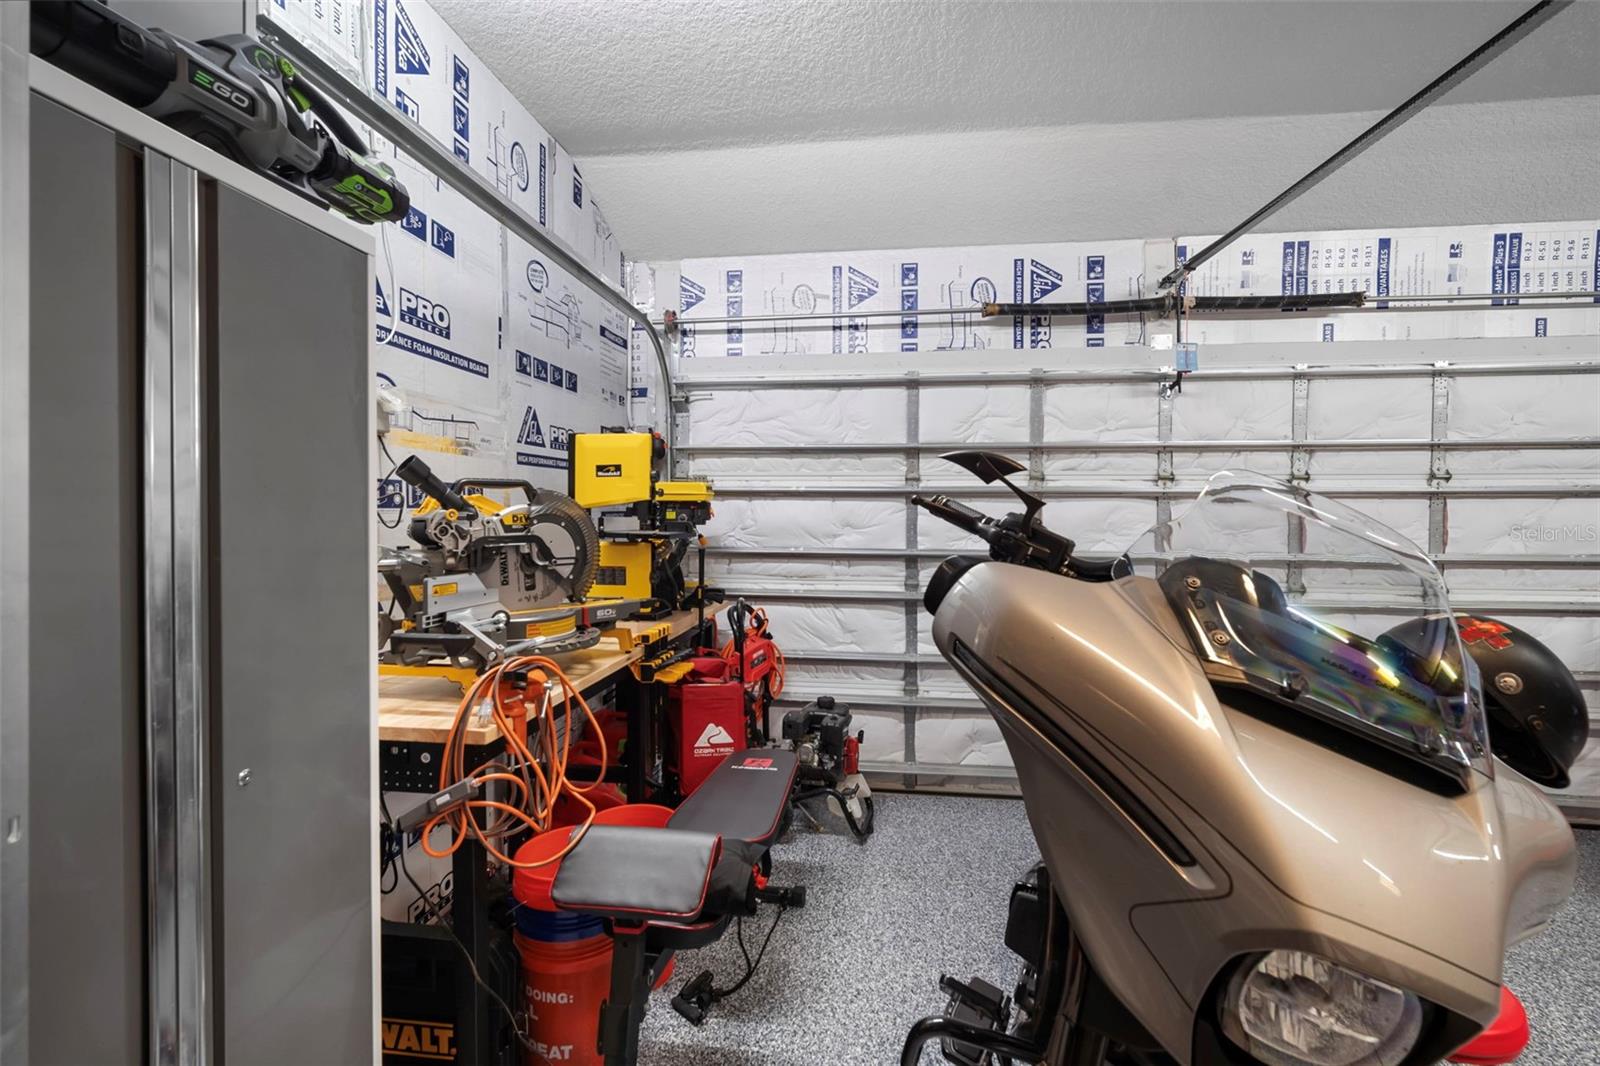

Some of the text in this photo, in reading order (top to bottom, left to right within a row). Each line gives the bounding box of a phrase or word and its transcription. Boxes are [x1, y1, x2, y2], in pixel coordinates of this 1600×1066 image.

[376, 9, 386, 94] PERFORMANCE
[398, 23, 420, 71] Sika
[194, 70, 249, 108] EGO
[1338, 248, 1346, 268] R-6.0
[1351, 248, 1359, 267] R-9.6
[1364, 246, 1373, 267] R-13.1
[1495, 240, 1504, 264] Plus-3
[1553, 240, 1561, 260] R-6.0
[1582, 237, 1590, 259] R-13.1
[1380, 249, 1388, 296] ADVANTAGES
[1523, 242, 1532, 287] inch R-3.2
[1537, 241, 1546, 287] inch R-5.0
[1565, 240, 1575, 286] inch R-9.6
[1033, 273, 1052, 298] Sika
[1551, 272, 1559, 287] inch
[1580, 271, 1588, 286] inch
[400, 287, 450, 329] PRO
[404, 315, 447, 337] SELECT
[413, 340, 432, 356] FOAM
[433, 348, 469, 367] INSULATION
[469, 362, 487, 375] BOARD
